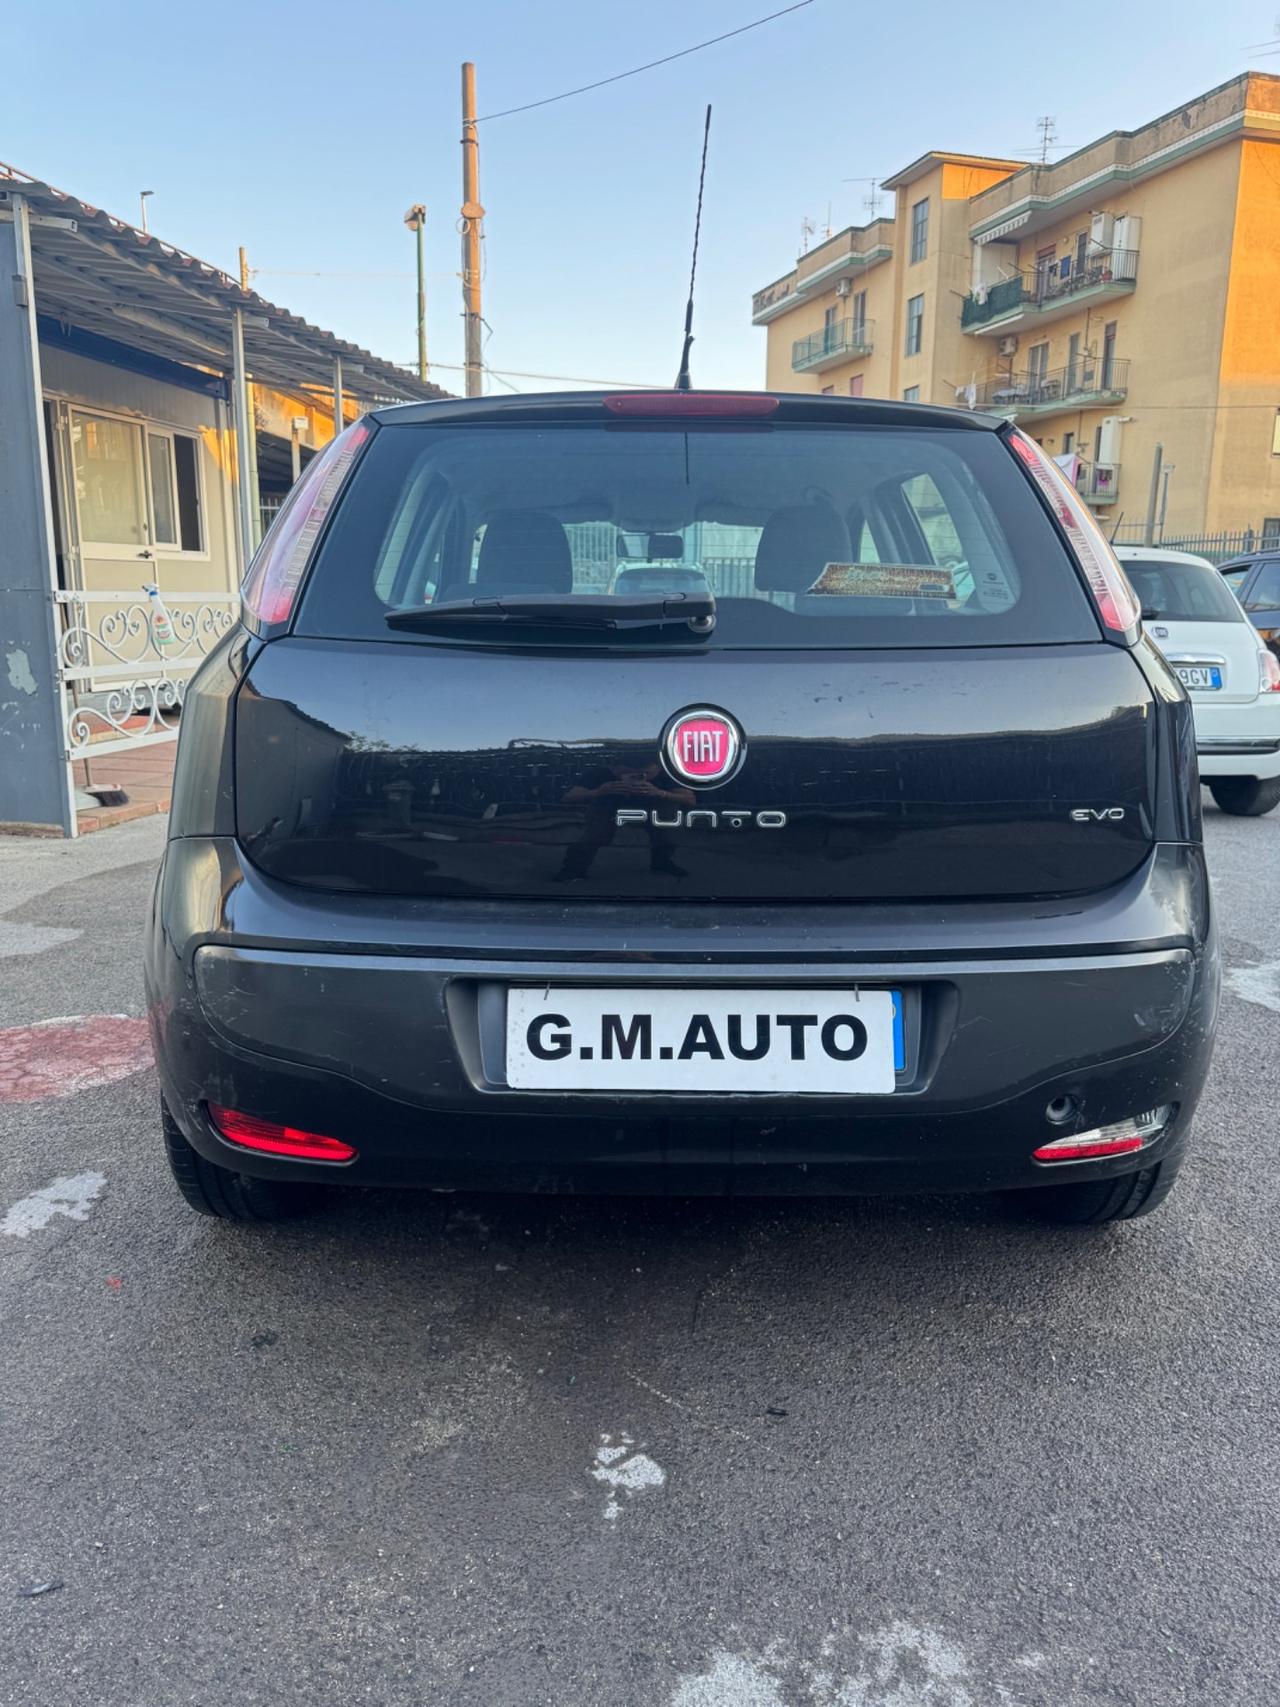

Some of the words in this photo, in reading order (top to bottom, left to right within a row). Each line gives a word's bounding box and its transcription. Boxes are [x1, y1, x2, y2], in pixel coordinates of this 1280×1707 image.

[682, 730, 724, 763] FIAT
[616, 809, 787, 828] PUNTO
[1071, 807, 1125, 821] EVO
[526, 1013, 868, 1062] G.M.AUTO
